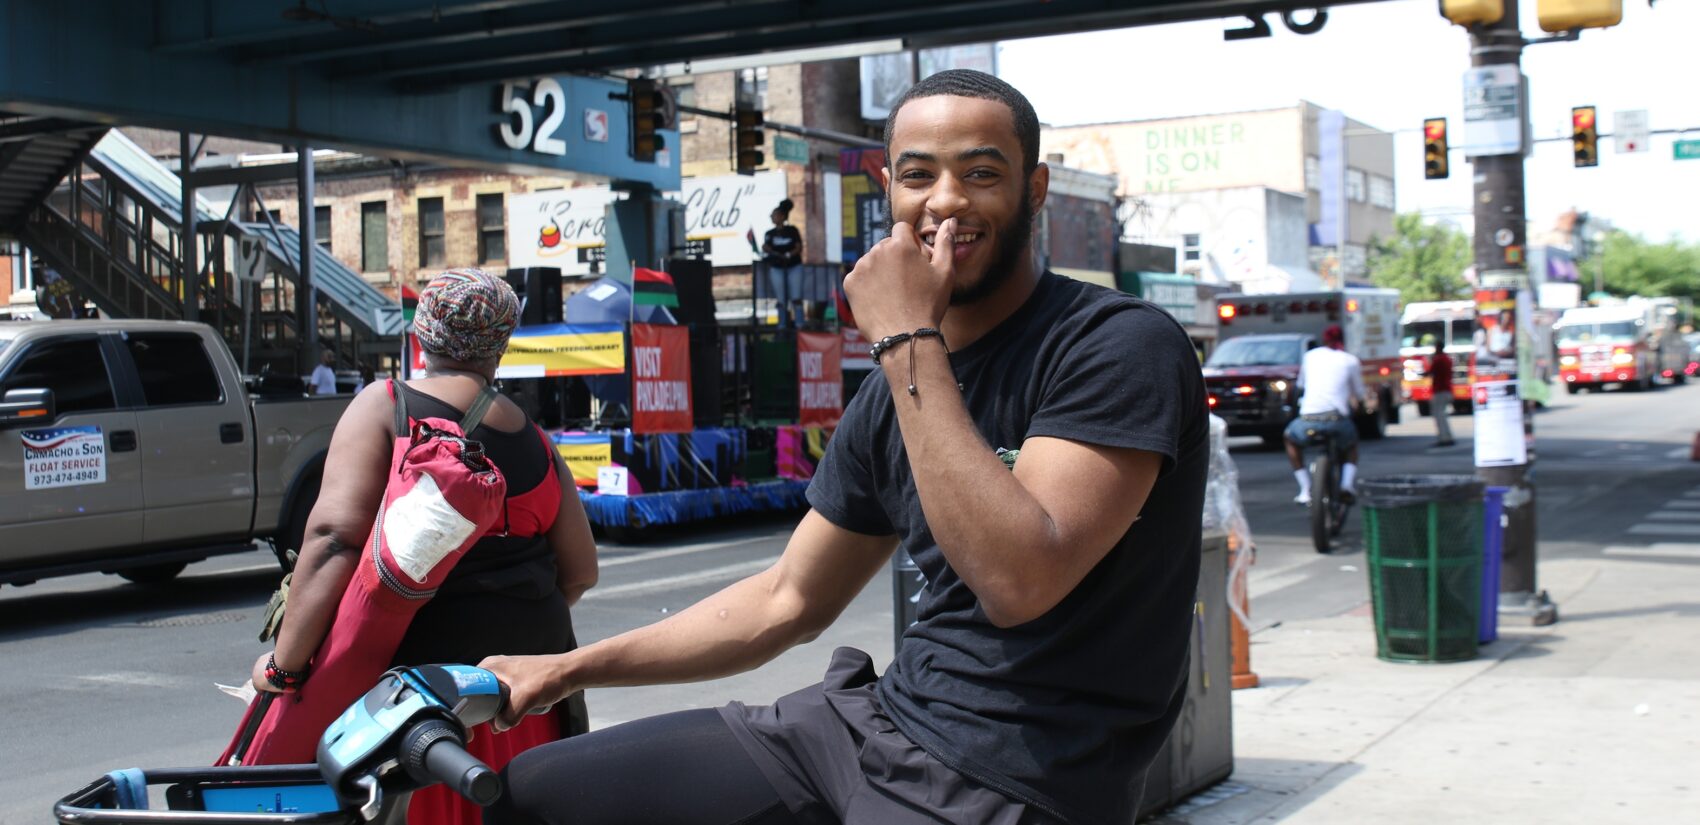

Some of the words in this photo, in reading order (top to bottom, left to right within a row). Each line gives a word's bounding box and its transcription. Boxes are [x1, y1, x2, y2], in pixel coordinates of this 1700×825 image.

[500, 78, 566, 155] 52
[1146, 122, 1245, 150] DINNER
[1147, 153, 1169, 175] IS
[1181, 150, 1220, 172] ON
[634, 346, 661, 378] VISIT
[25, 447, 73, 460] CAMACHO
[82, 442, 103, 455] SON
[29, 461, 60, 473] FLOAT
[62, 458, 101, 470] SERVICE
[34, 470, 98, 485] 973-474-4949
[613, 472, 621, 486] 7
